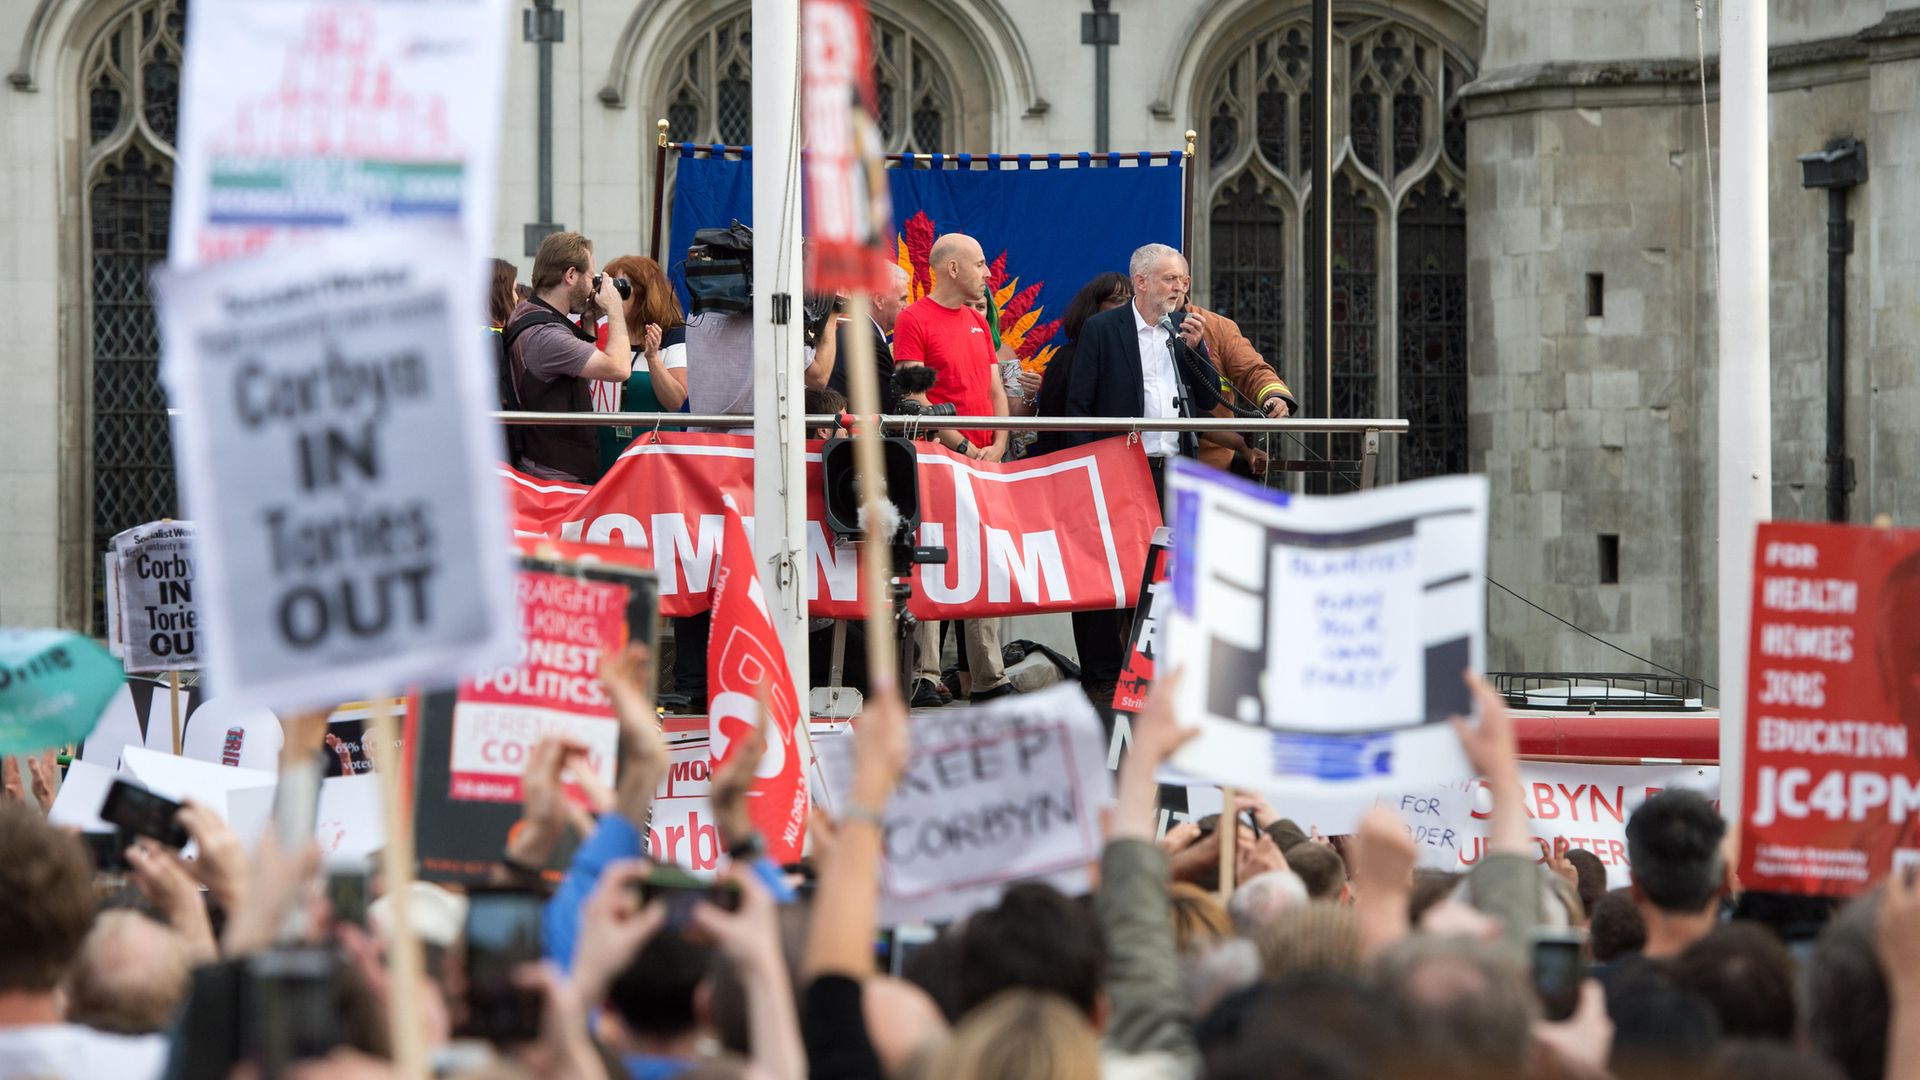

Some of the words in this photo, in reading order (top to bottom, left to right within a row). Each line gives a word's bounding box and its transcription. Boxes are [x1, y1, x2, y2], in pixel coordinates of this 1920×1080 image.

[233, 343, 430, 430] Corbyn
[297, 424, 382, 492] IN
[263, 505, 434, 574] Tories
[1765, 542, 1818, 568] FOR
[159, 579, 193, 605] IN
[277, 565, 434, 650] OUT
[516, 575, 615, 615] RAIGHT
[1762, 576, 1858, 614] HEALTH
[145, 605, 199, 631] Torie
[523, 611, 602, 645] LKING,
[150, 632, 199, 657] OU
[1760, 624, 1854, 663] HOMES
[1759, 670, 1826, 709] JOBS
[1757, 716, 1908, 758] EDUCATION
[1400, 794, 1441, 816] FOR
[1752, 765, 1920, 828] JC4PM
